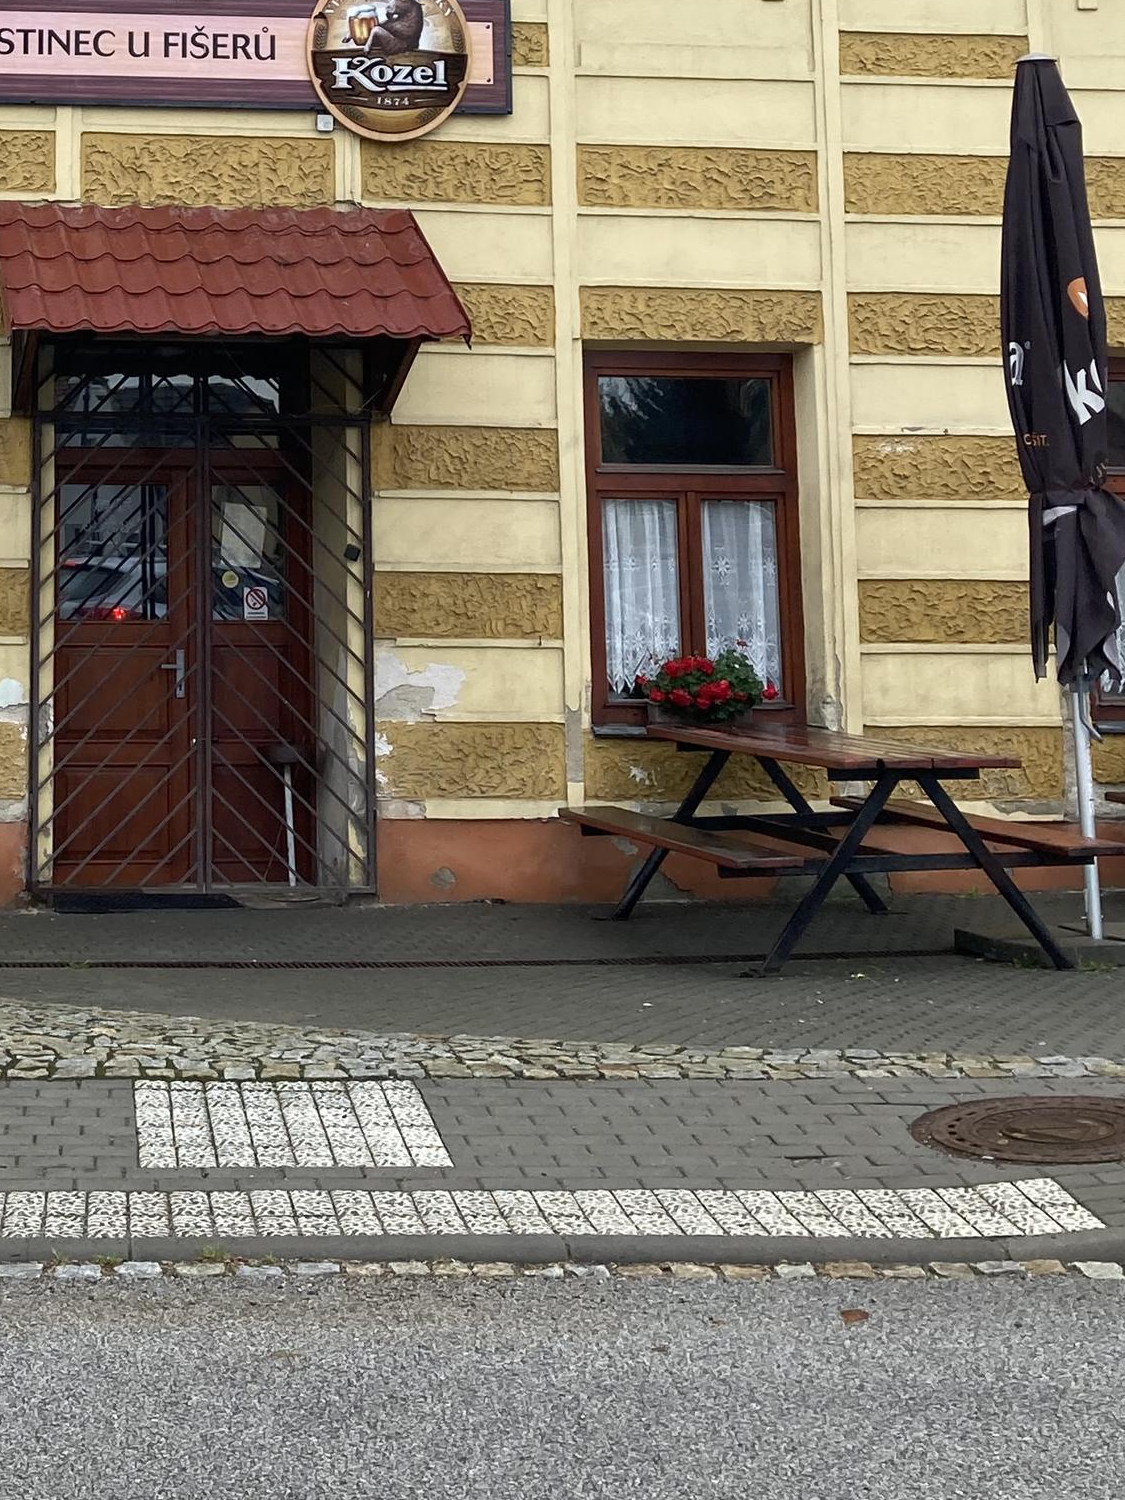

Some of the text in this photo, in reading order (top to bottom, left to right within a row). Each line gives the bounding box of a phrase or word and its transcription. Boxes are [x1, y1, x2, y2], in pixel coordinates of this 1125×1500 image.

[128, 31, 150, 58] U
[163, 25, 276, 61] FIŠERŮ
[331, 56, 448, 92] Kozel
[376, 96, 410, 106] 1874
